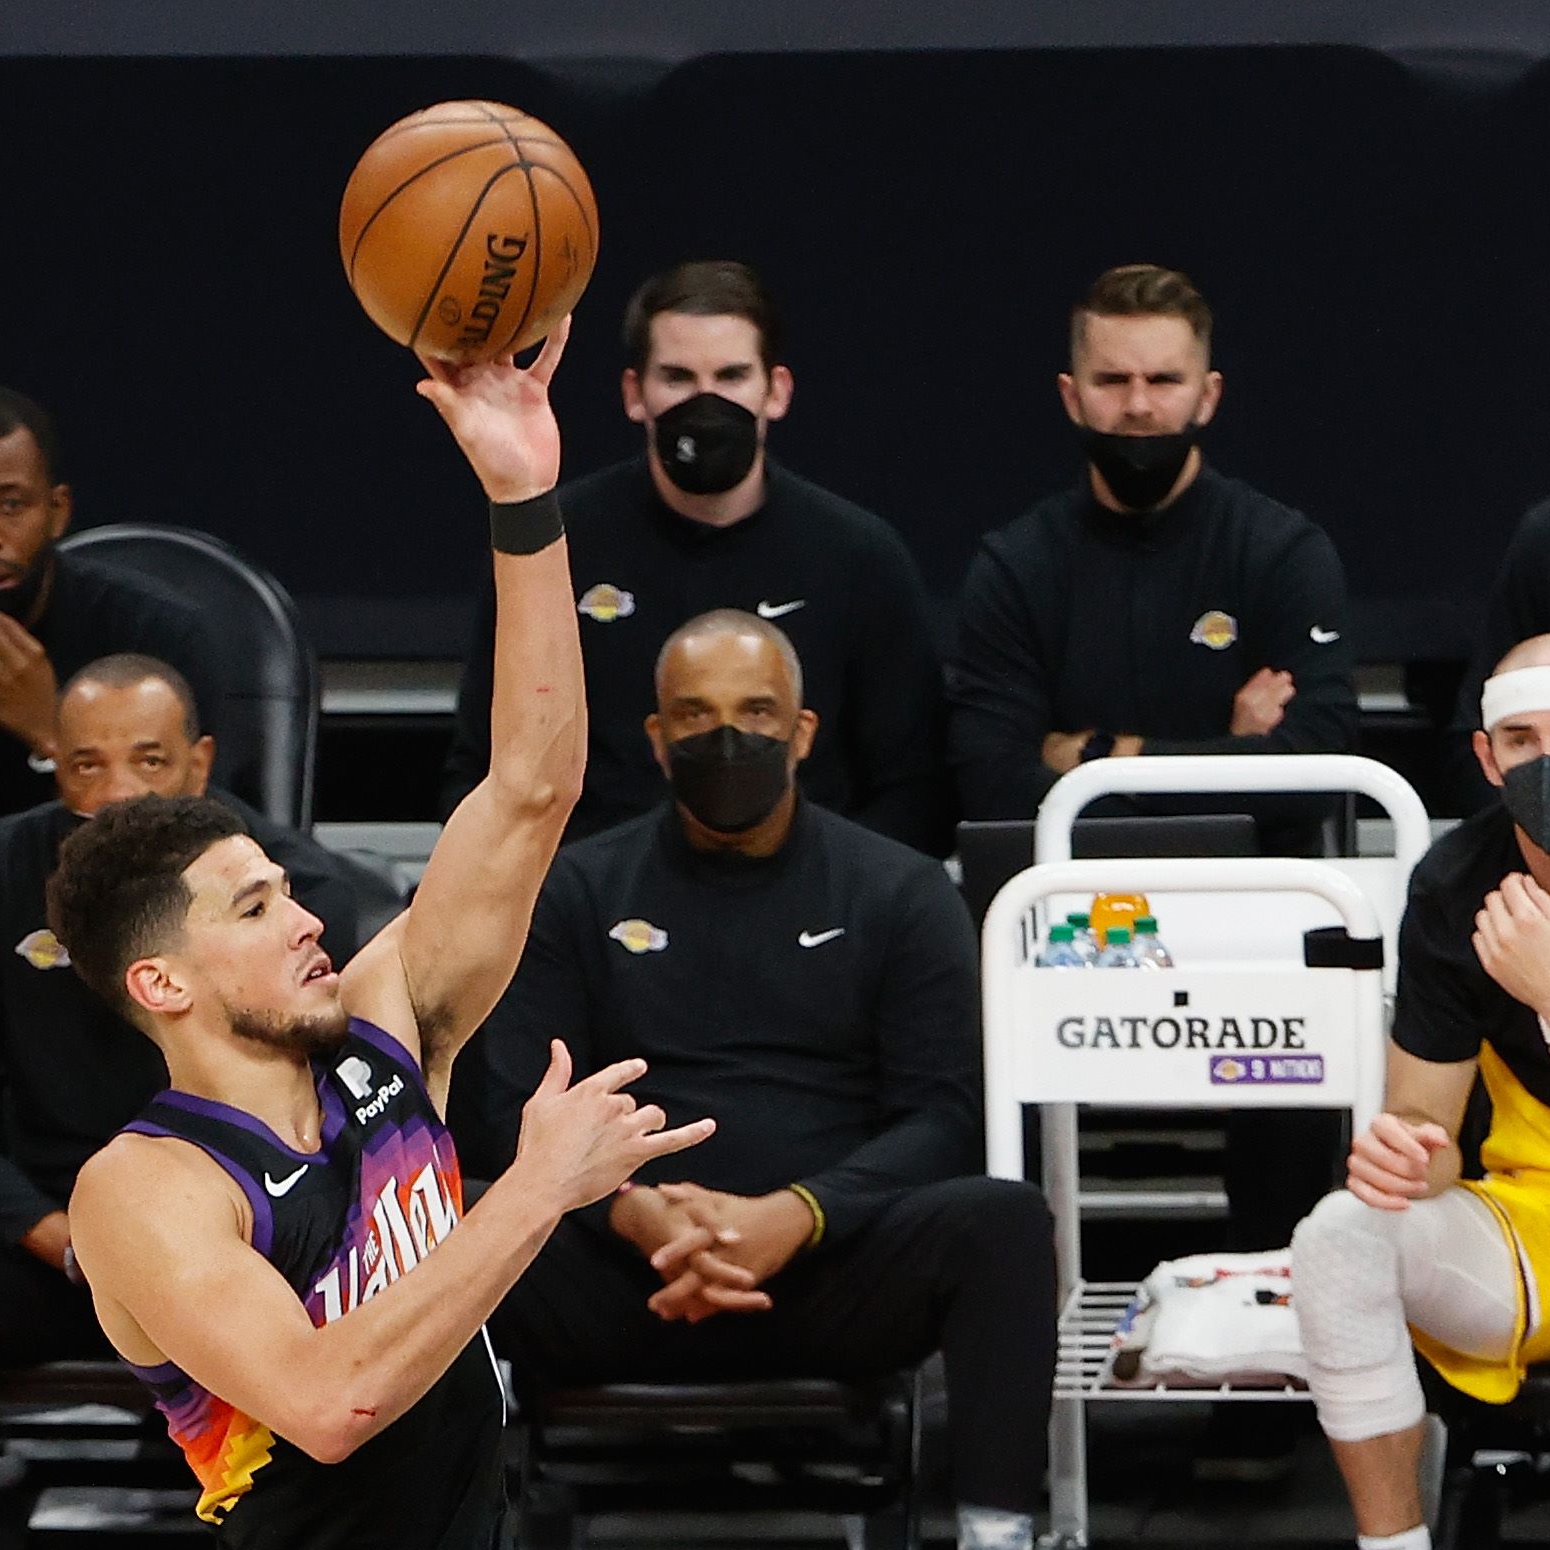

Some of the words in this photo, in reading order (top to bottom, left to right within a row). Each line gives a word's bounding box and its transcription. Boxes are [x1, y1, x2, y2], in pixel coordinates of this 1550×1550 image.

[458, 232, 527, 347] ALDING
[1056, 1017, 1305, 1049] GATORADE
[355, 1074, 405, 1126] PayPal
